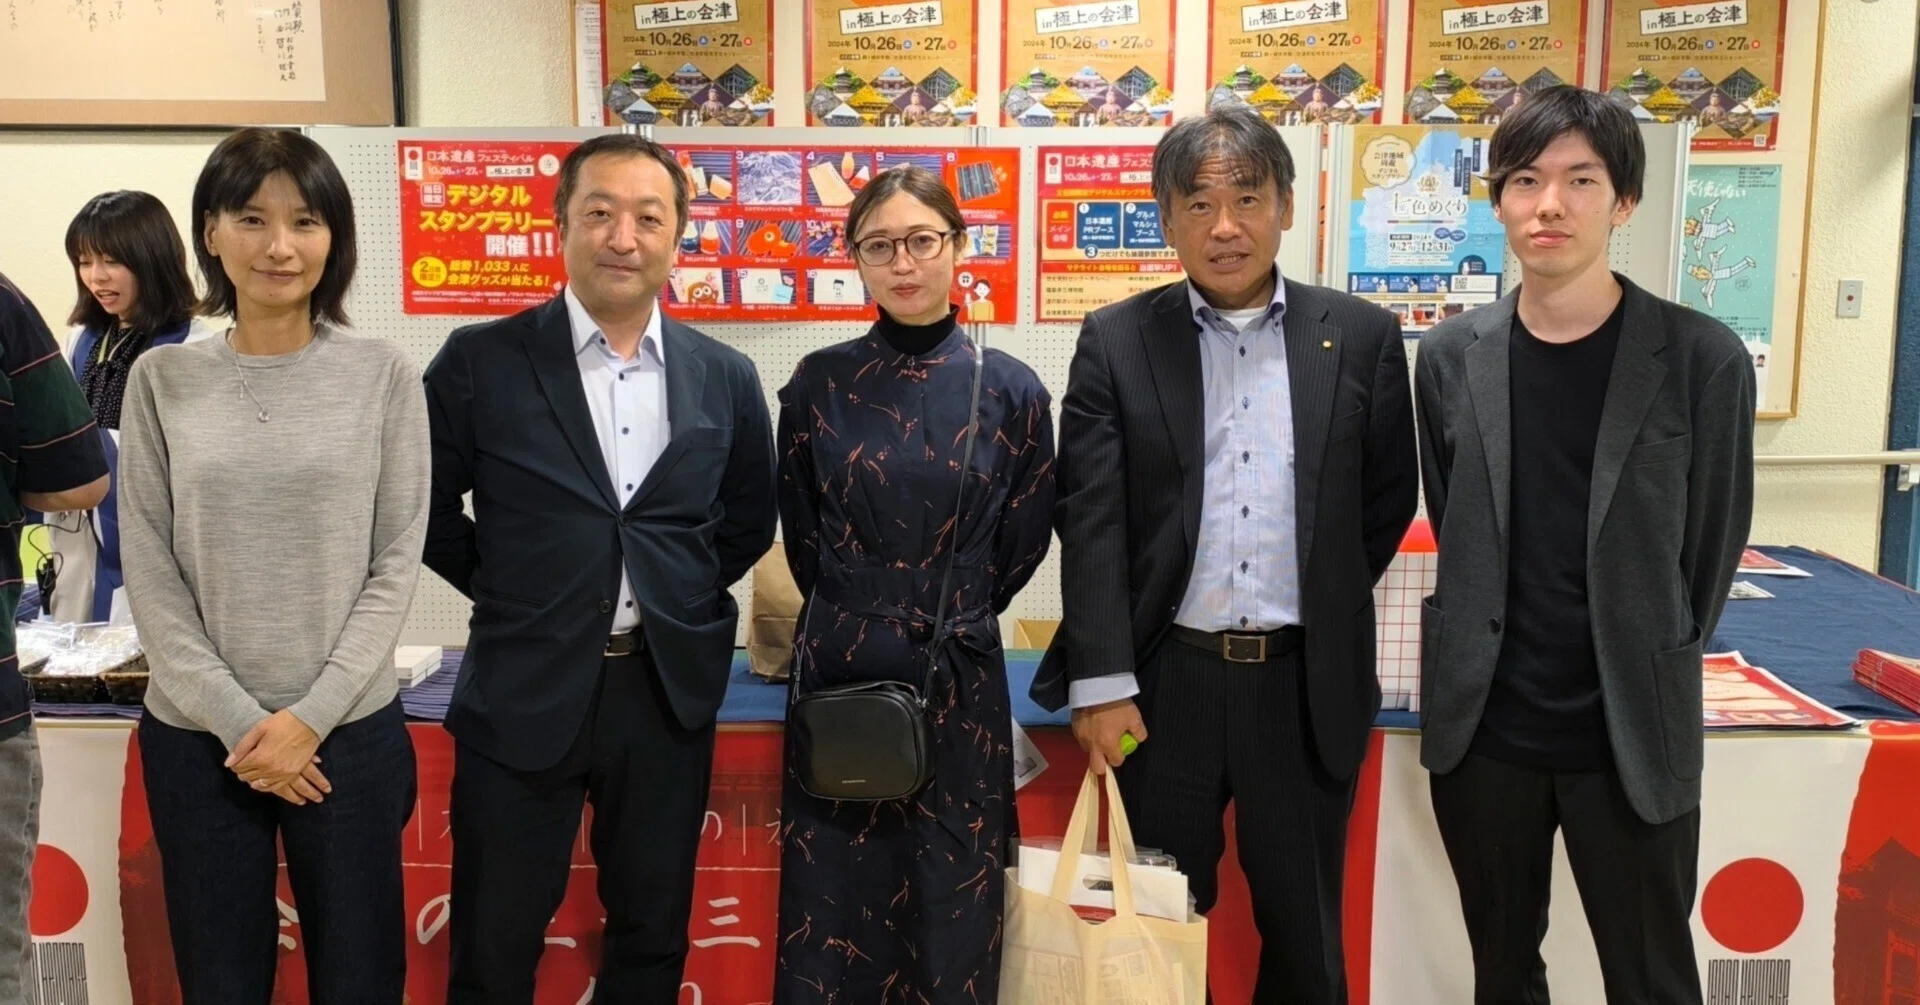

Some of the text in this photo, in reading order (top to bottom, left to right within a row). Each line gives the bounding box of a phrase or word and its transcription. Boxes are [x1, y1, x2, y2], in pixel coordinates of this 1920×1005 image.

[641, 3, 732, 25] in極上の会津
[846, 6, 937, 29] in極上の会津
[1042, 5, 1133, 29] in極上の会津
[1249, 2, 1342, 26] in極上の会津
[1449, 6, 1543, 29] in極上の会津
[1647, 5, 1741, 29] in極上の会津
[426, 150, 476, 163] 日本遺産
[1065, 155, 1120, 168] 日本遺産
[446, 184, 532, 206] デジタル
[419, 210, 554, 233] スタンプラリー
[1136, 211, 1156, 220] グルメ
